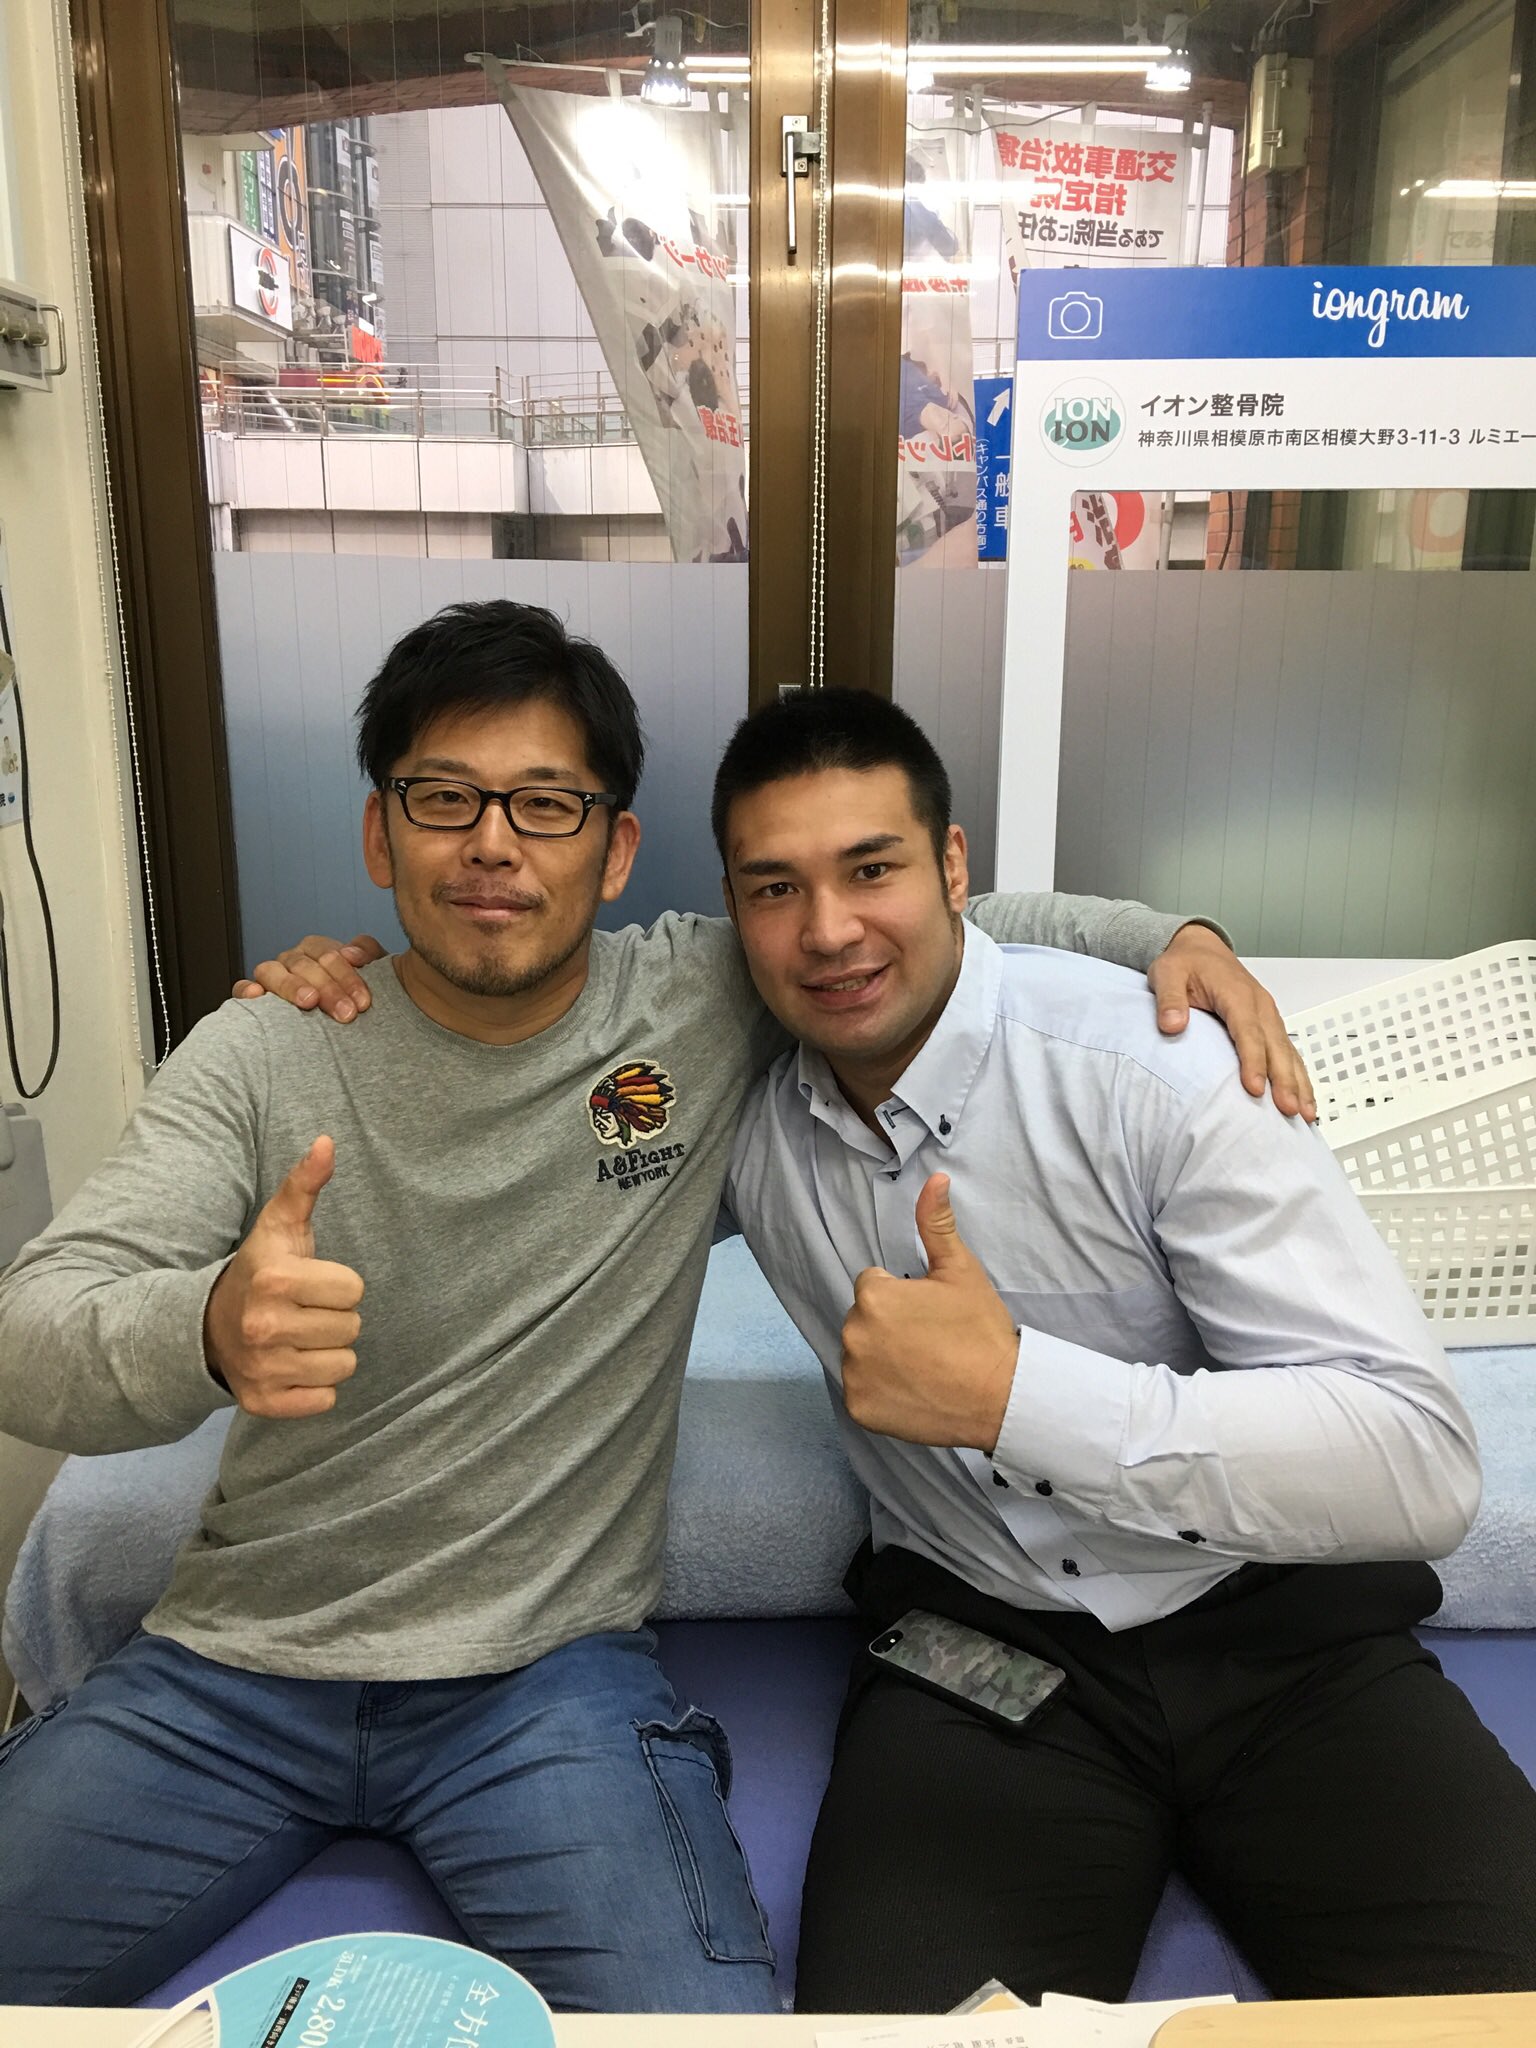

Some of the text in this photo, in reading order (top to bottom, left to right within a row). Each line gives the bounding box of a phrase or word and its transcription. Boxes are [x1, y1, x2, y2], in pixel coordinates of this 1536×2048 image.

[1312, 281, 1470, 348] iongram
[1054, 397, 1113, 421] ION
[1140, 393, 1285, 417] イオン整骨院
[1053, 420, 1111, 443] ION
[1137, 428, 1536, 447] 神奈川県相模原市南区相模大野3-11-3 ルミエー
[296, 1950, 355, 2048] 3LDK 2,80
